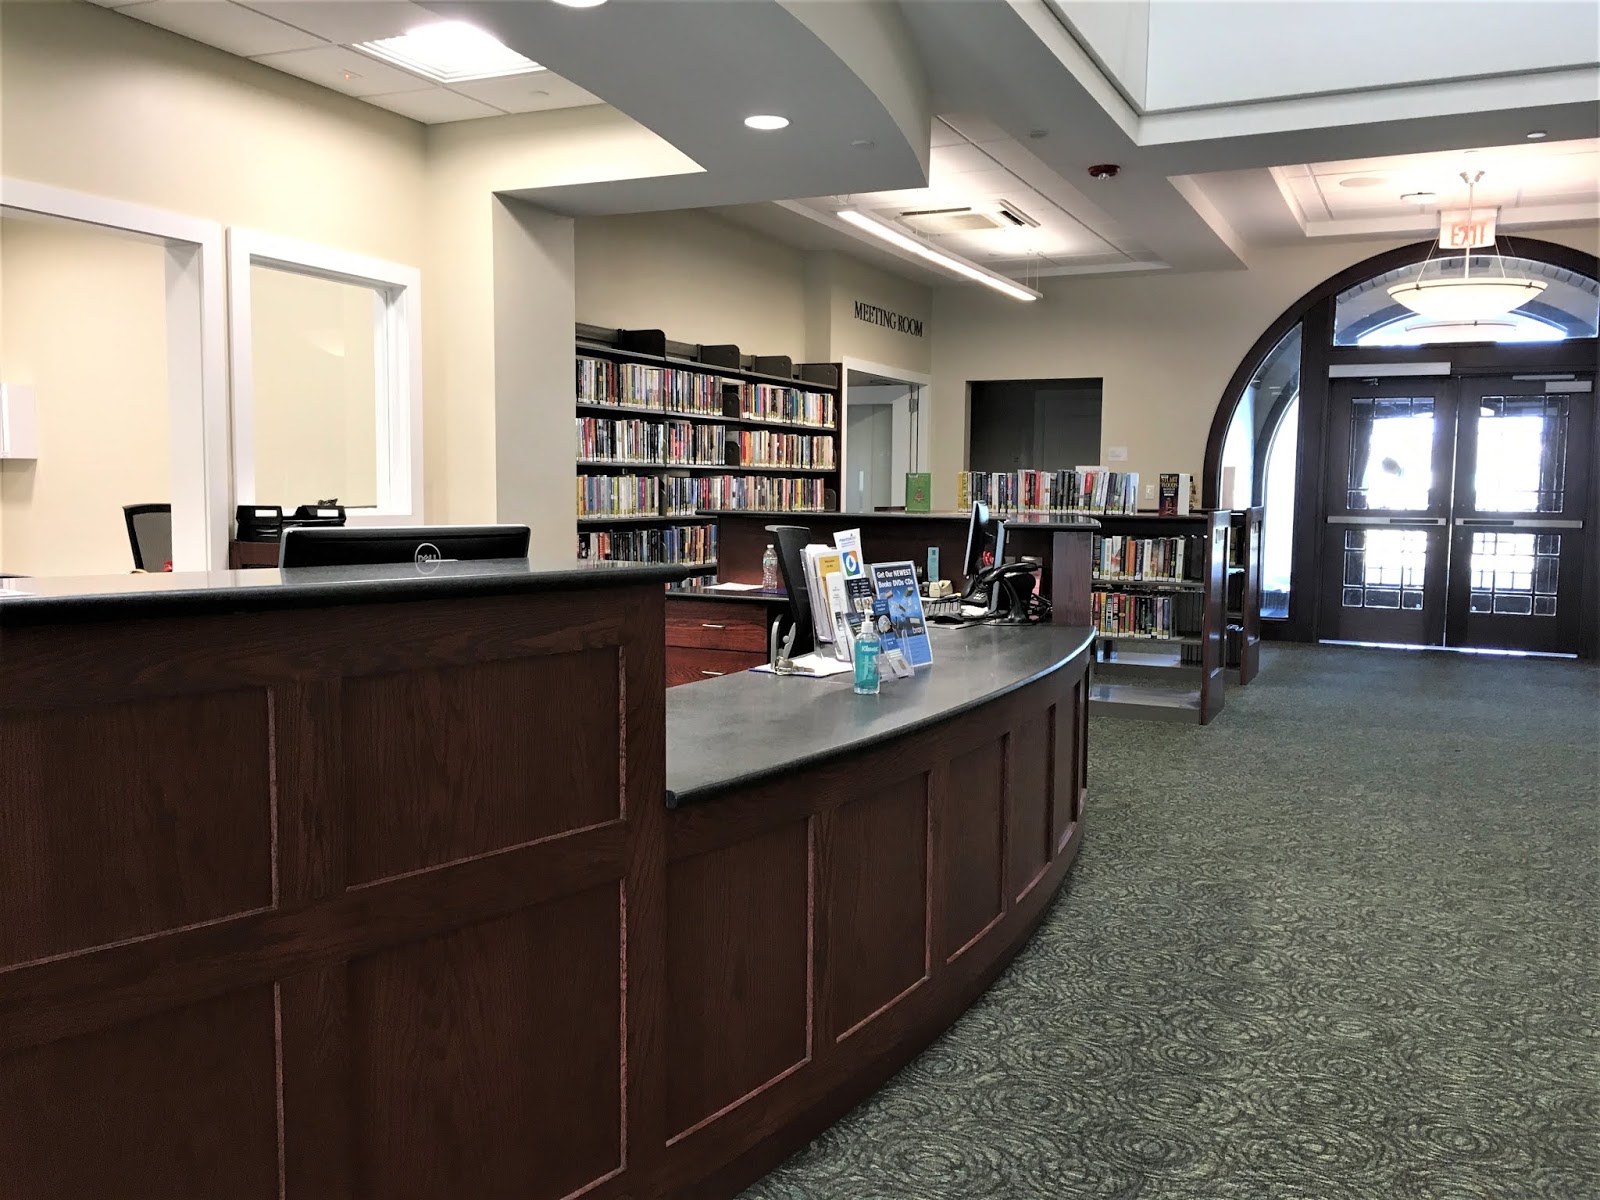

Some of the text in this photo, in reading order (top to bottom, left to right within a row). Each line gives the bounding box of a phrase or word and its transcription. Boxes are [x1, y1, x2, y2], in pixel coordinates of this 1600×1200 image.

[1451, 221, 1488, 246] EXIT
[854, 301, 923, 337] MEETING ROOM
[885, 570, 893, 578] Our
[893, 569, 912, 577] NEWEST
[892, 579, 904, 587] DVDs
